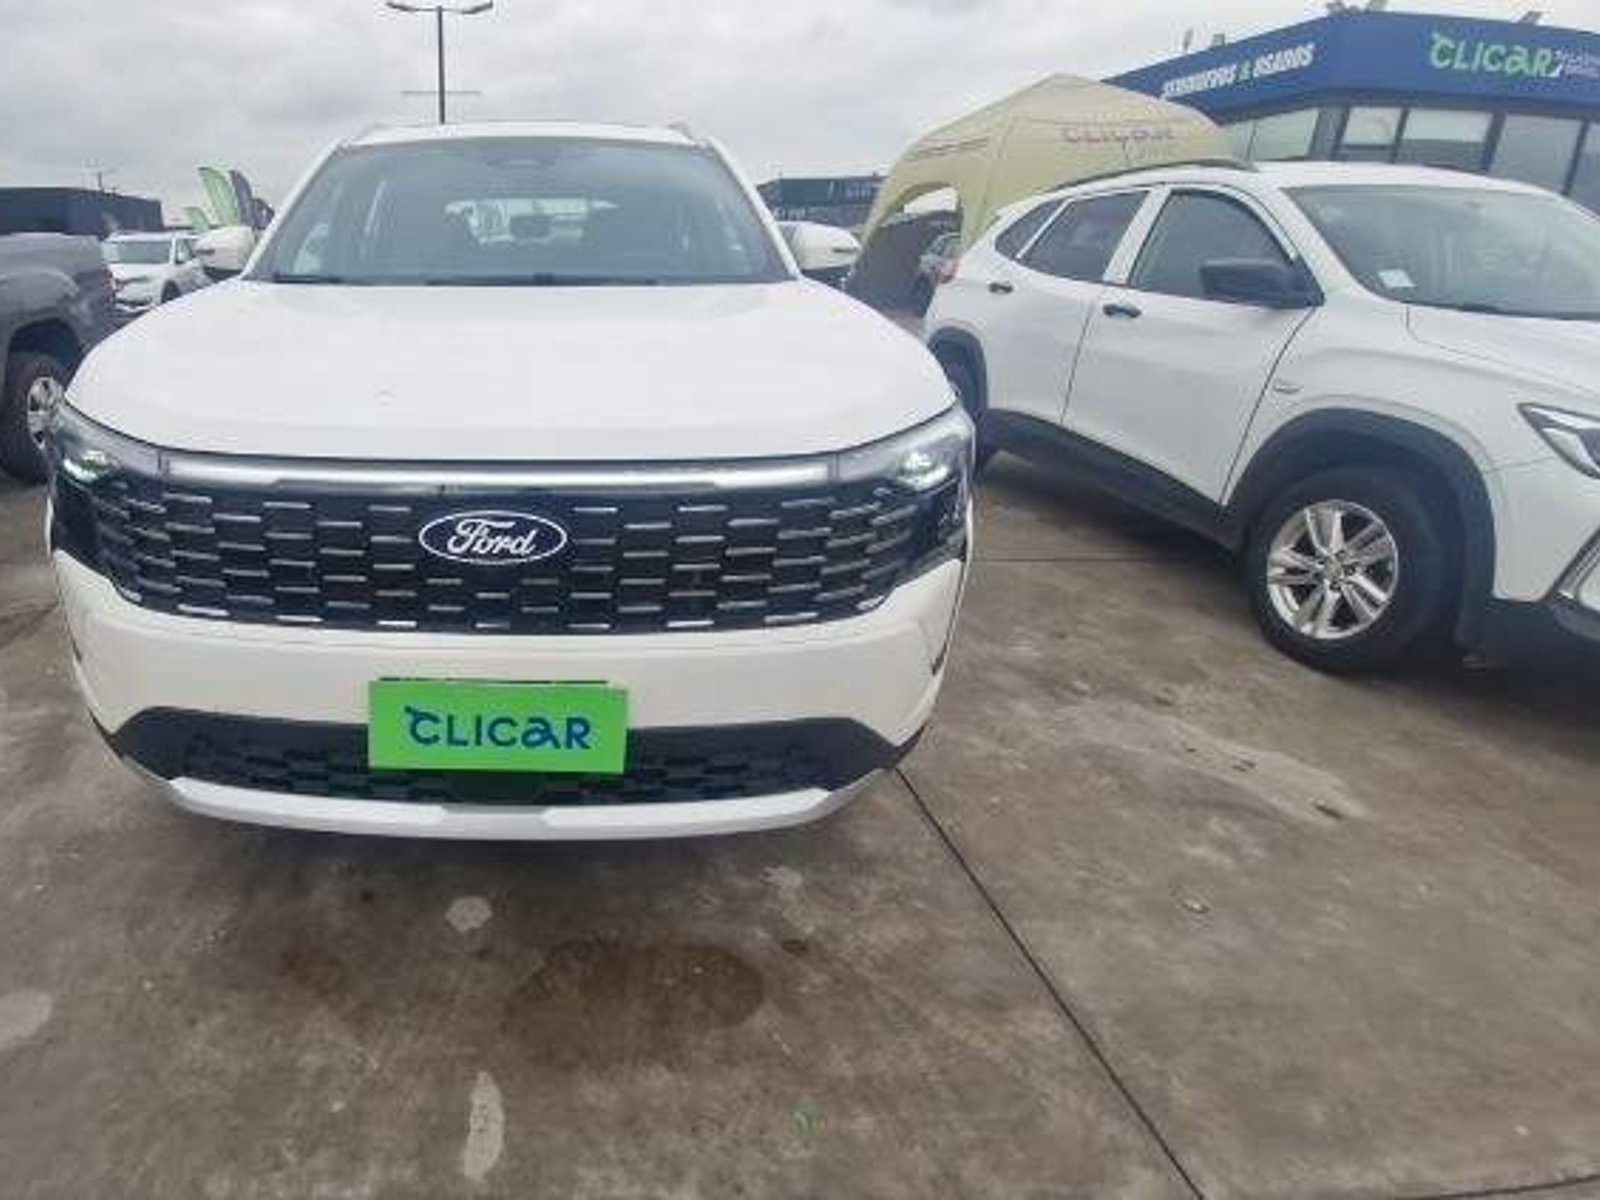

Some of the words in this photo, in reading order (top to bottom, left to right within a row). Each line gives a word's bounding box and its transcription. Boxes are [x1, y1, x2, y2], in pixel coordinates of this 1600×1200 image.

[1430, 32, 1552, 77] CLICAR
[447, 518, 536, 555] Ford
[404, 705, 592, 750] CLICAR
